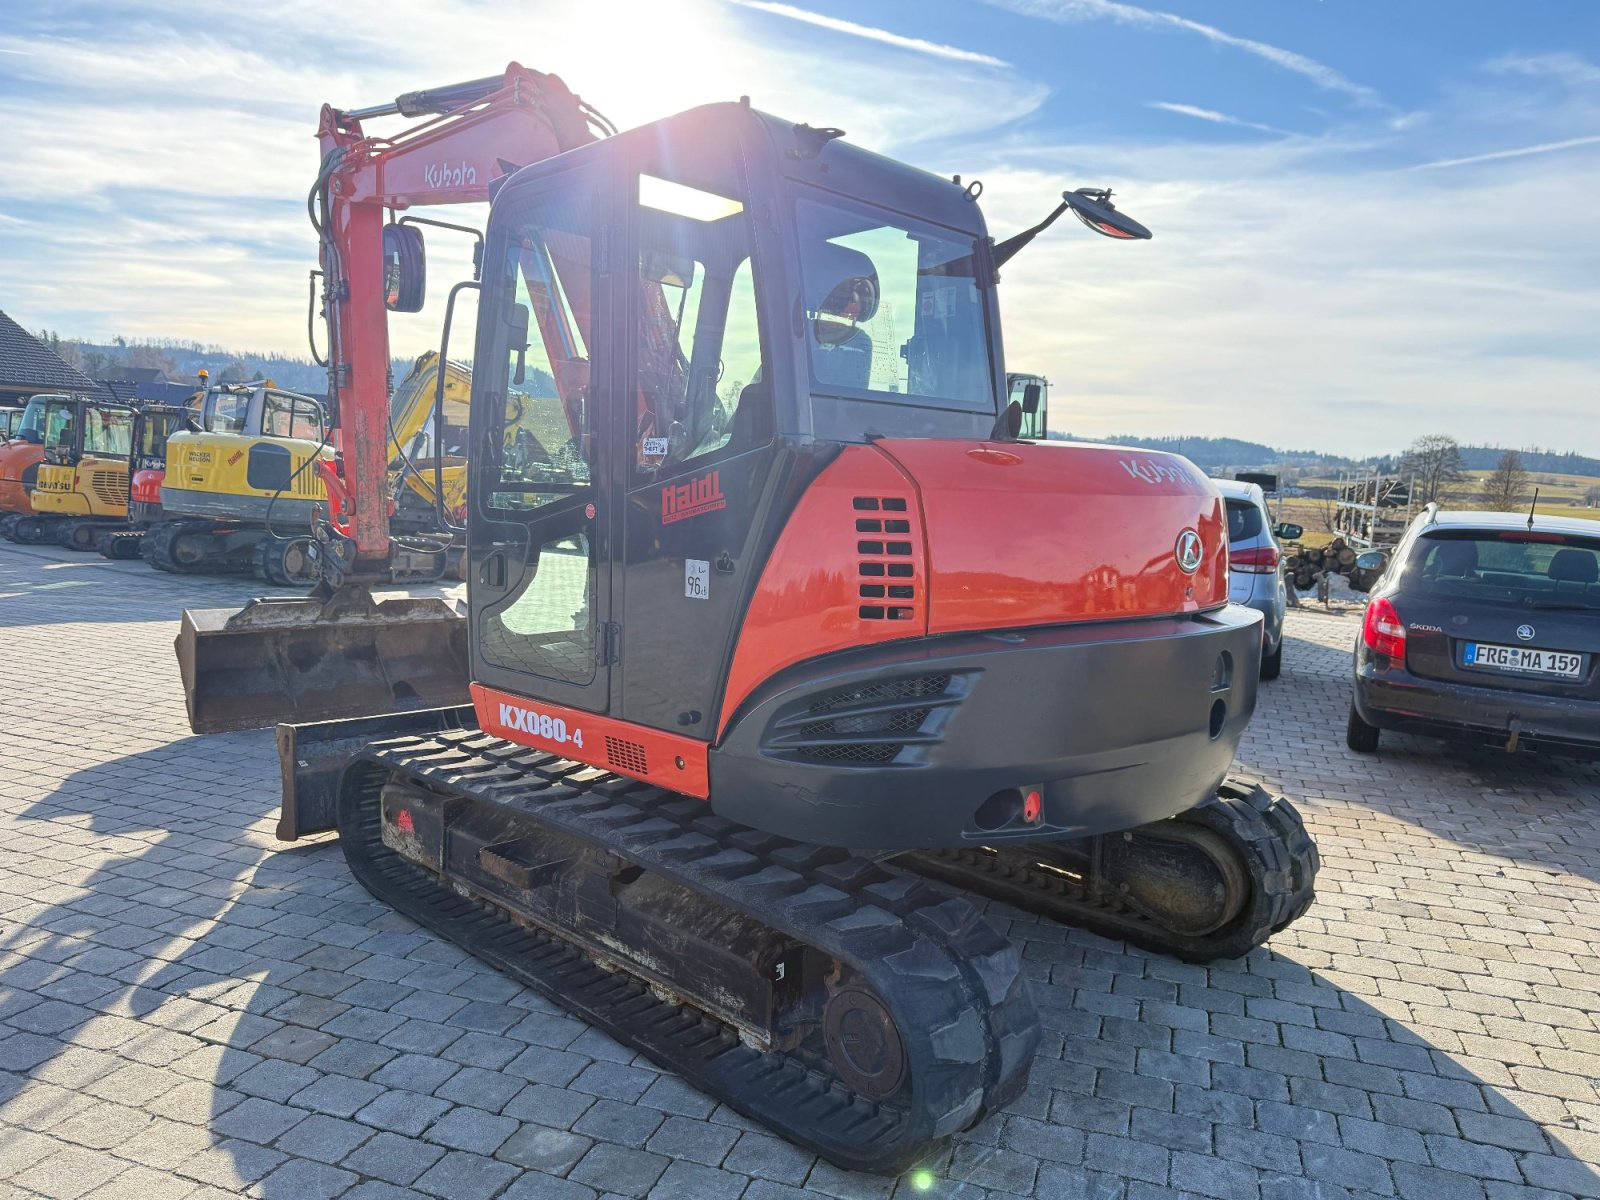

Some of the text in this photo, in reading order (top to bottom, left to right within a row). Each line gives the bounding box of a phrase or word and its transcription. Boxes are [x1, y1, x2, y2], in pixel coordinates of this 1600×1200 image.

[424, 161, 476, 188] Kubota
[662, 471, 724, 517] Haidl
[688, 576, 700, 595] 96
[1410, 623, 1442, 632] ŠKODA
[1475, 647, 1510, 665] FRG
[1521, 653, 1542, 669] MA
[1547, 655, 1580, 673] 159
[499, 702, 584, 749] KX080-4
